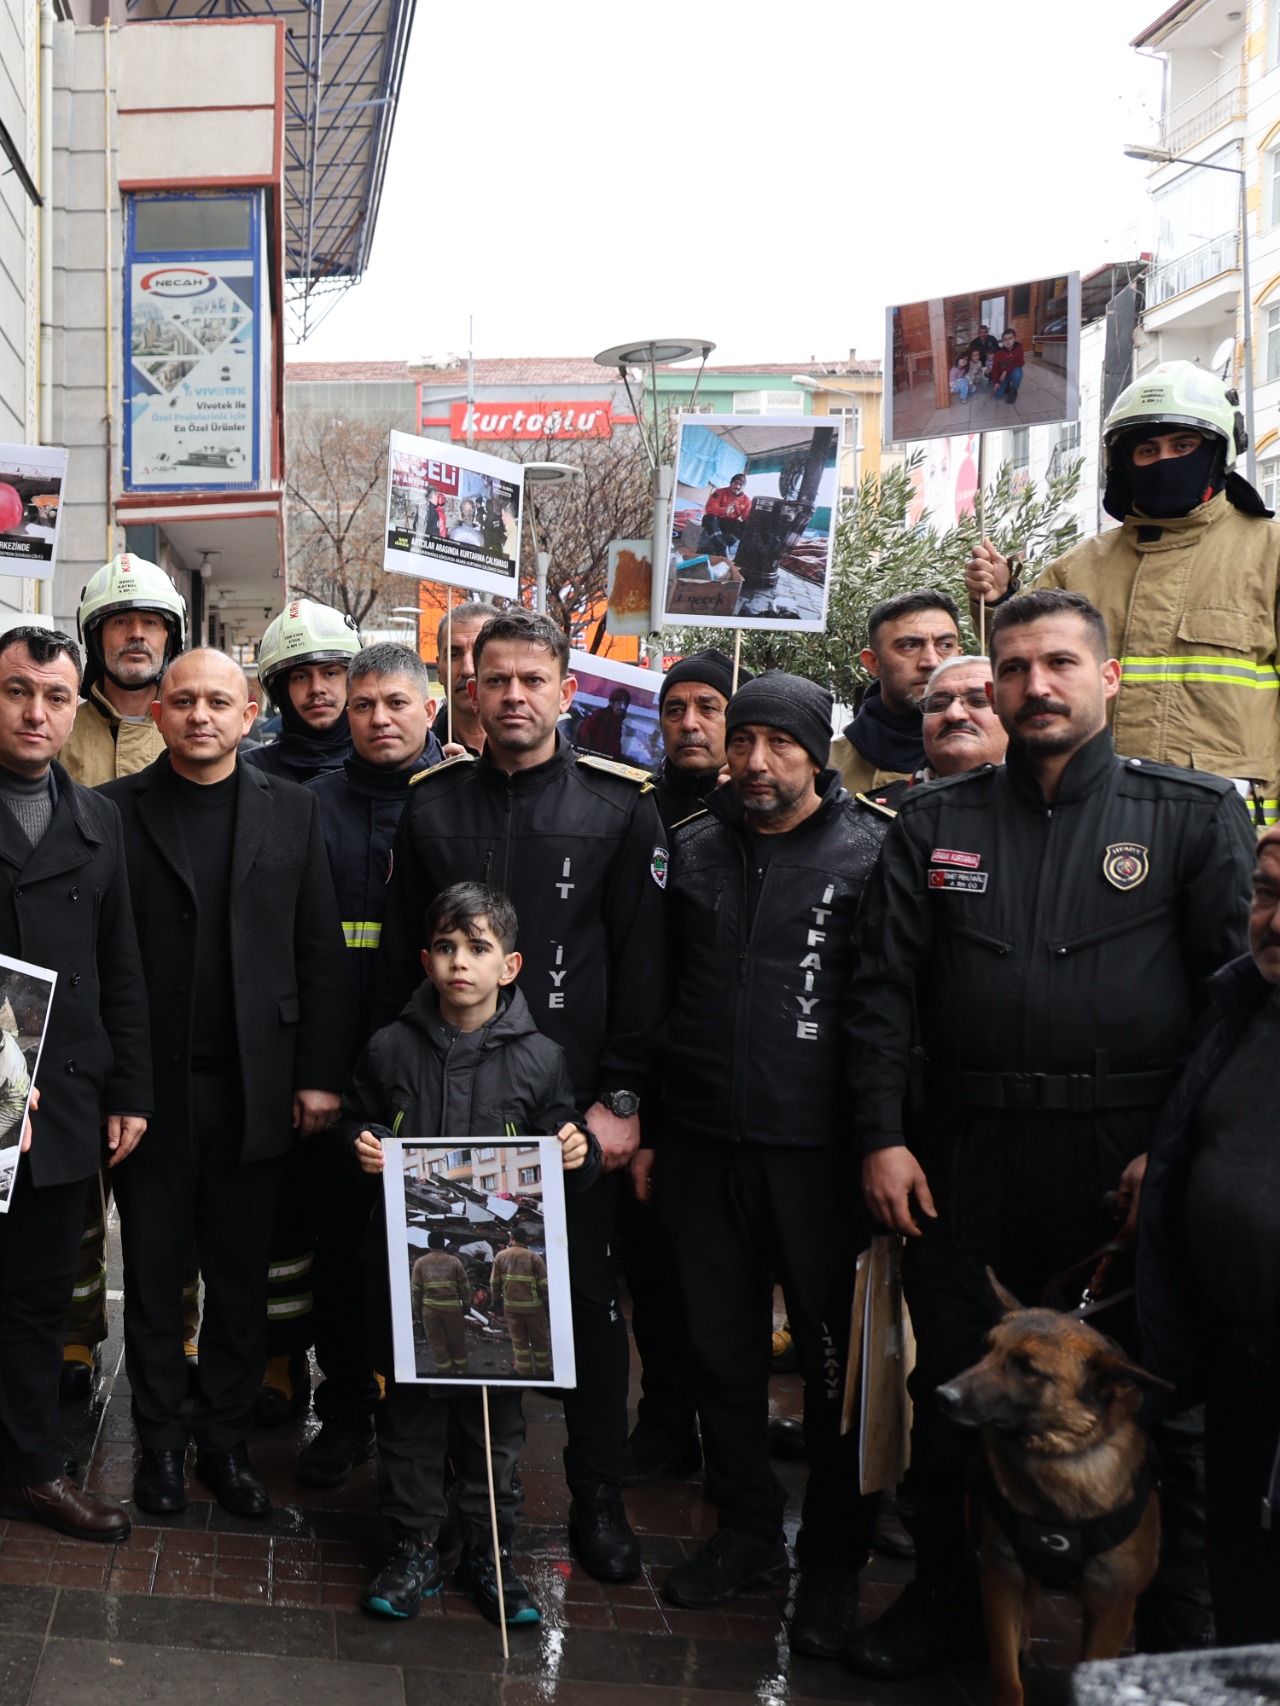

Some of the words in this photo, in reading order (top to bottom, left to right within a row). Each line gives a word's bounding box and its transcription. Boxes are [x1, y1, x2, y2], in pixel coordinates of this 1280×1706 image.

[155, 279, 203, 287] NECAH
[194, 387, 247, 397] VIVOTEK
[196, 401, 232, 410] Vivotek
[235, 401, 247, 409] ile
[151, 411, 172, 422] Özel
[174, 425, 186, 433] En
[188, 422, 210, 433] Özel
[211, 422, 247, 432] Ürünler
[795, 883, 837, 1041] İTFAİYE
